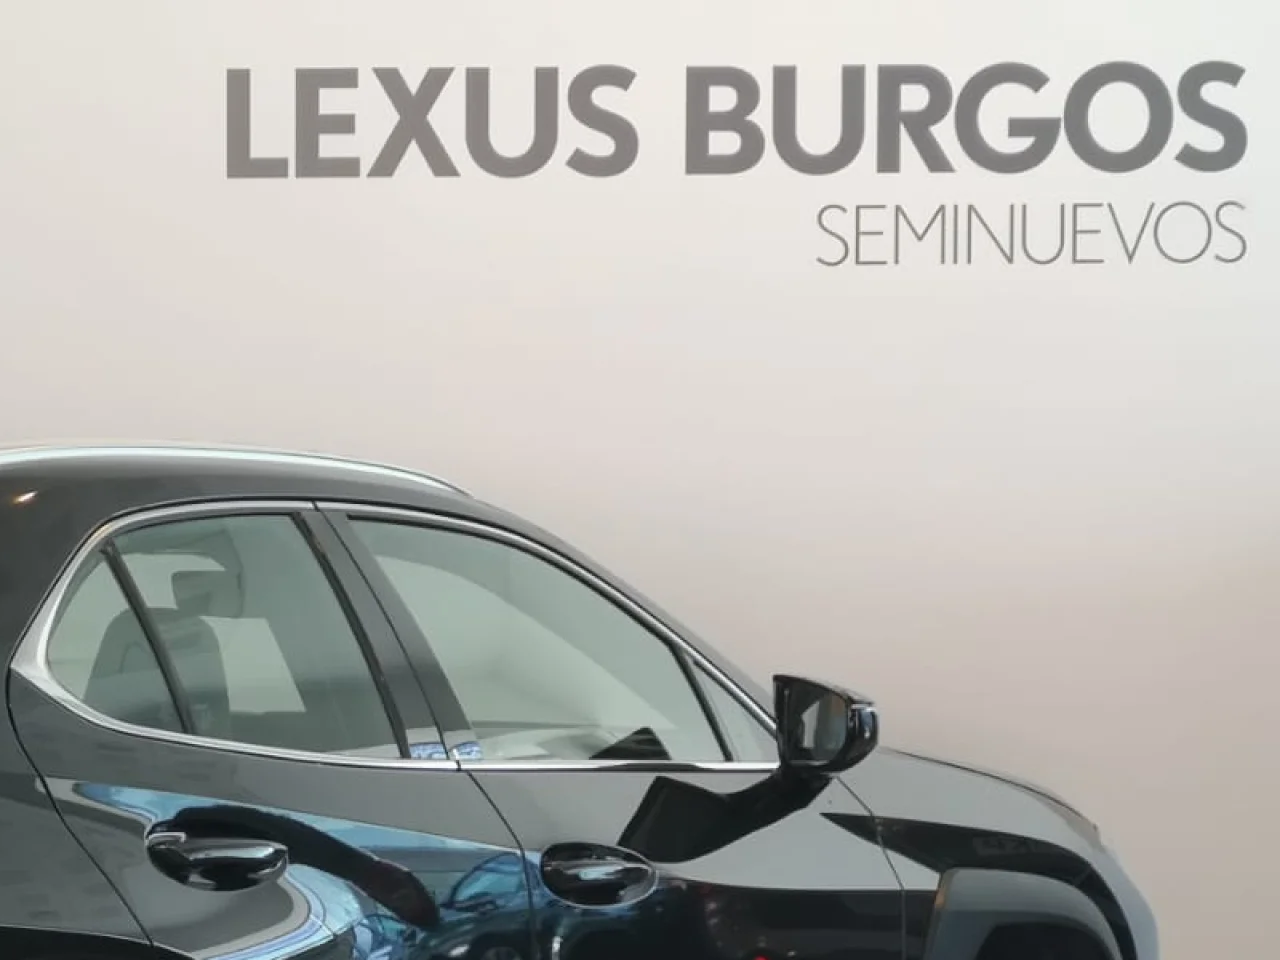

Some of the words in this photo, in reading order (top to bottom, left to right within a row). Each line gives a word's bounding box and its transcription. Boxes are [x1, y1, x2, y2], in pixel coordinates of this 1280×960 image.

[226, 64, 639, 179] LEXUS
[684, 60, 1248, 175] BURGOS
[816, 200, 1248, 268] SEMINUEVOS
